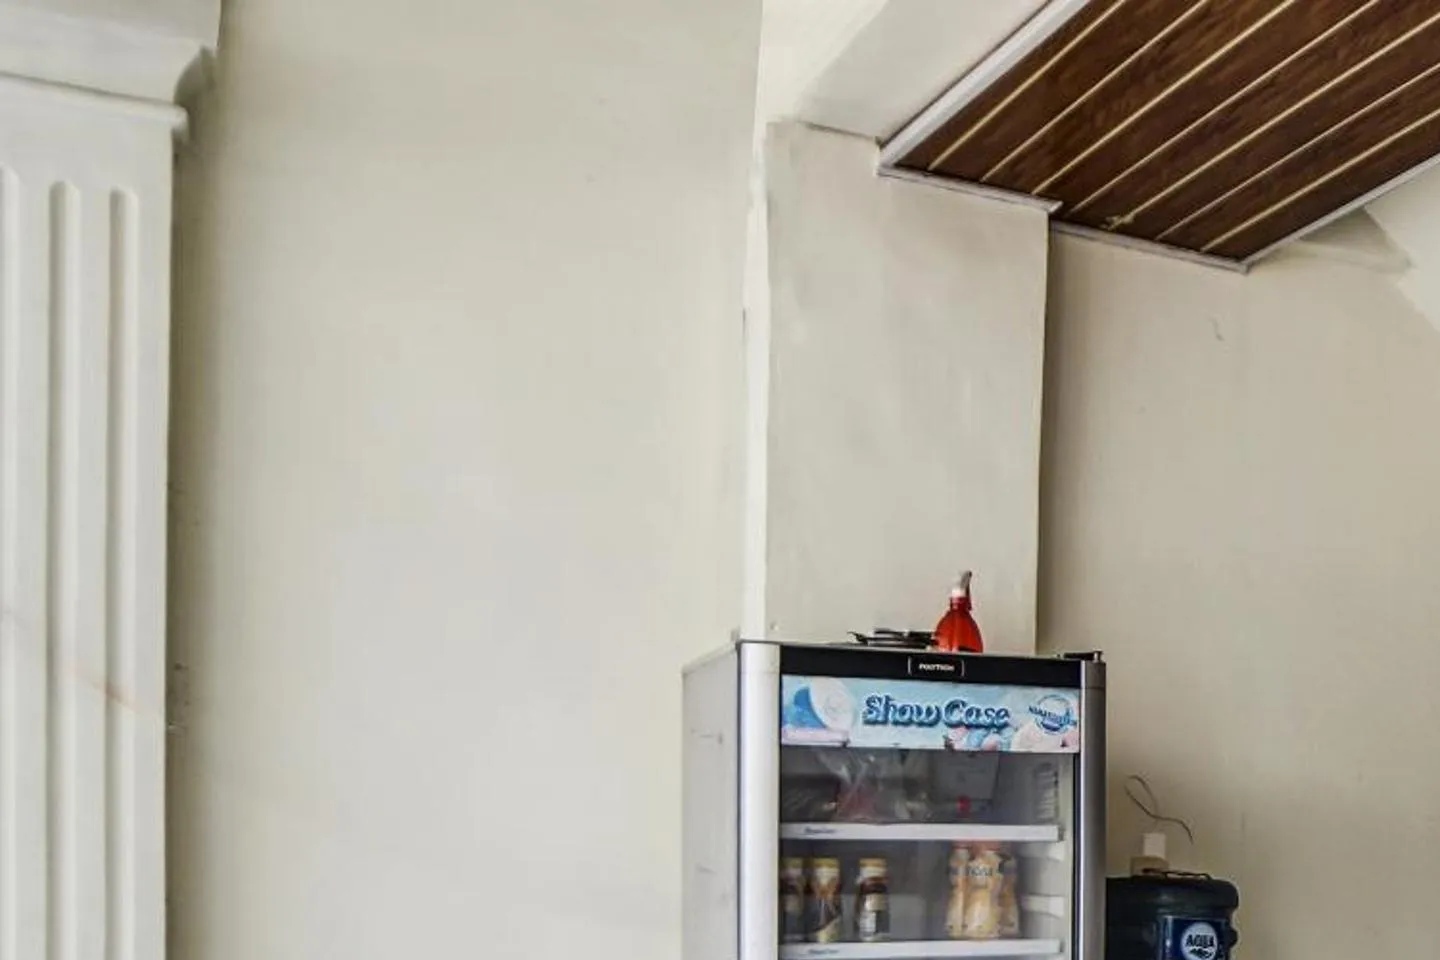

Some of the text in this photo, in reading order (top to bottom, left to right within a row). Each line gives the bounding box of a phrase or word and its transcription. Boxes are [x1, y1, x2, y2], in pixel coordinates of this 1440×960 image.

[863, 693, 942, 726] Show
[943, 699, 1010, 729] Case
[1185, 934, 1215, 948] AQUA
